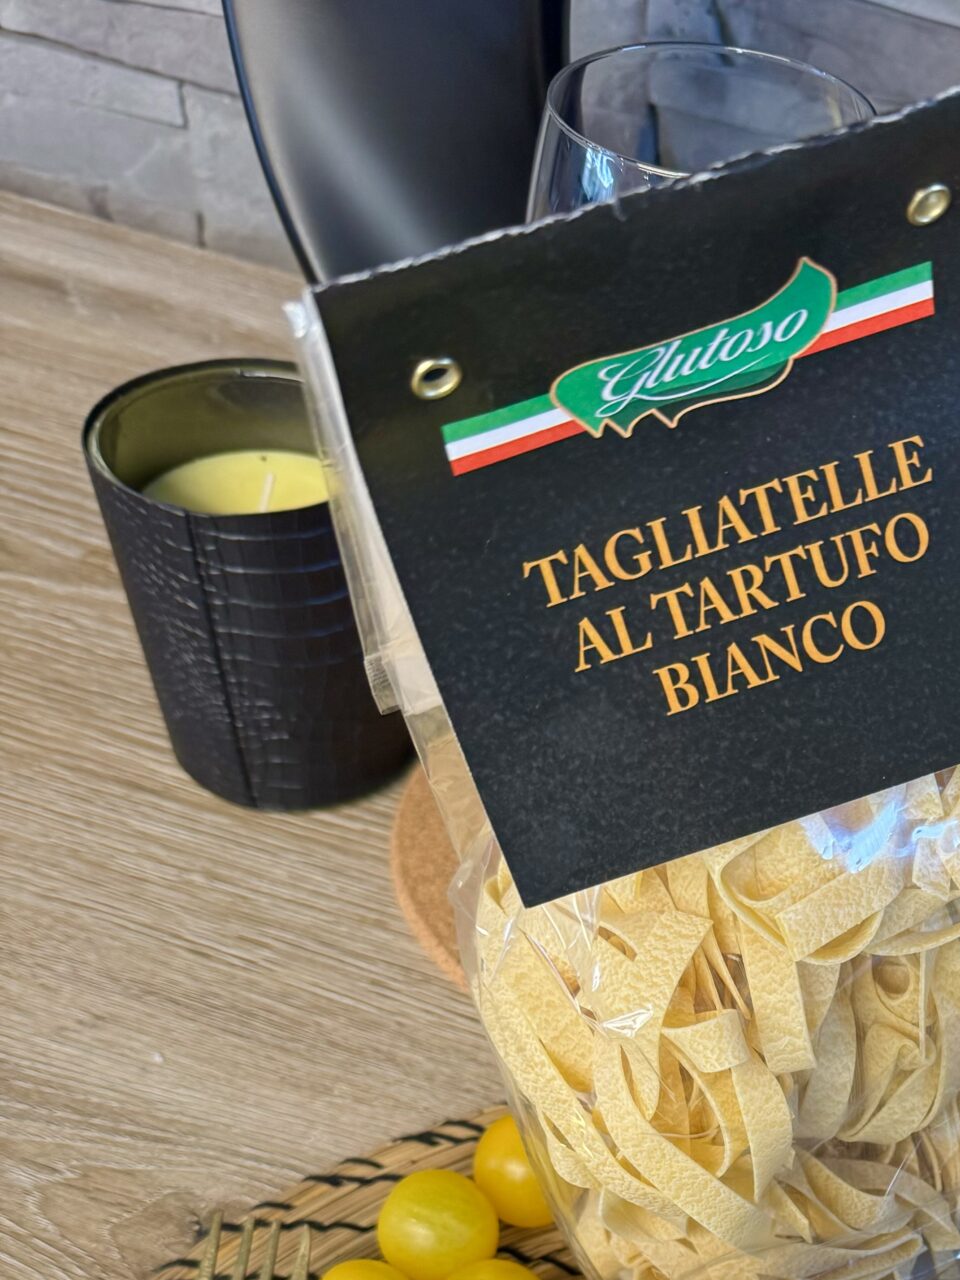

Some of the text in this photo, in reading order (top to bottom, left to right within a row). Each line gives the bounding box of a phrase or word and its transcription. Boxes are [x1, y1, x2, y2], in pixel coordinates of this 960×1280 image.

[595, 308, 808, 418] Glutoso
[522, 435, 934, 607] TAGLIATELLE
[574, 512, 931, 673] AL TARTUFO
[653, 600, 886, 716] BIANCO
